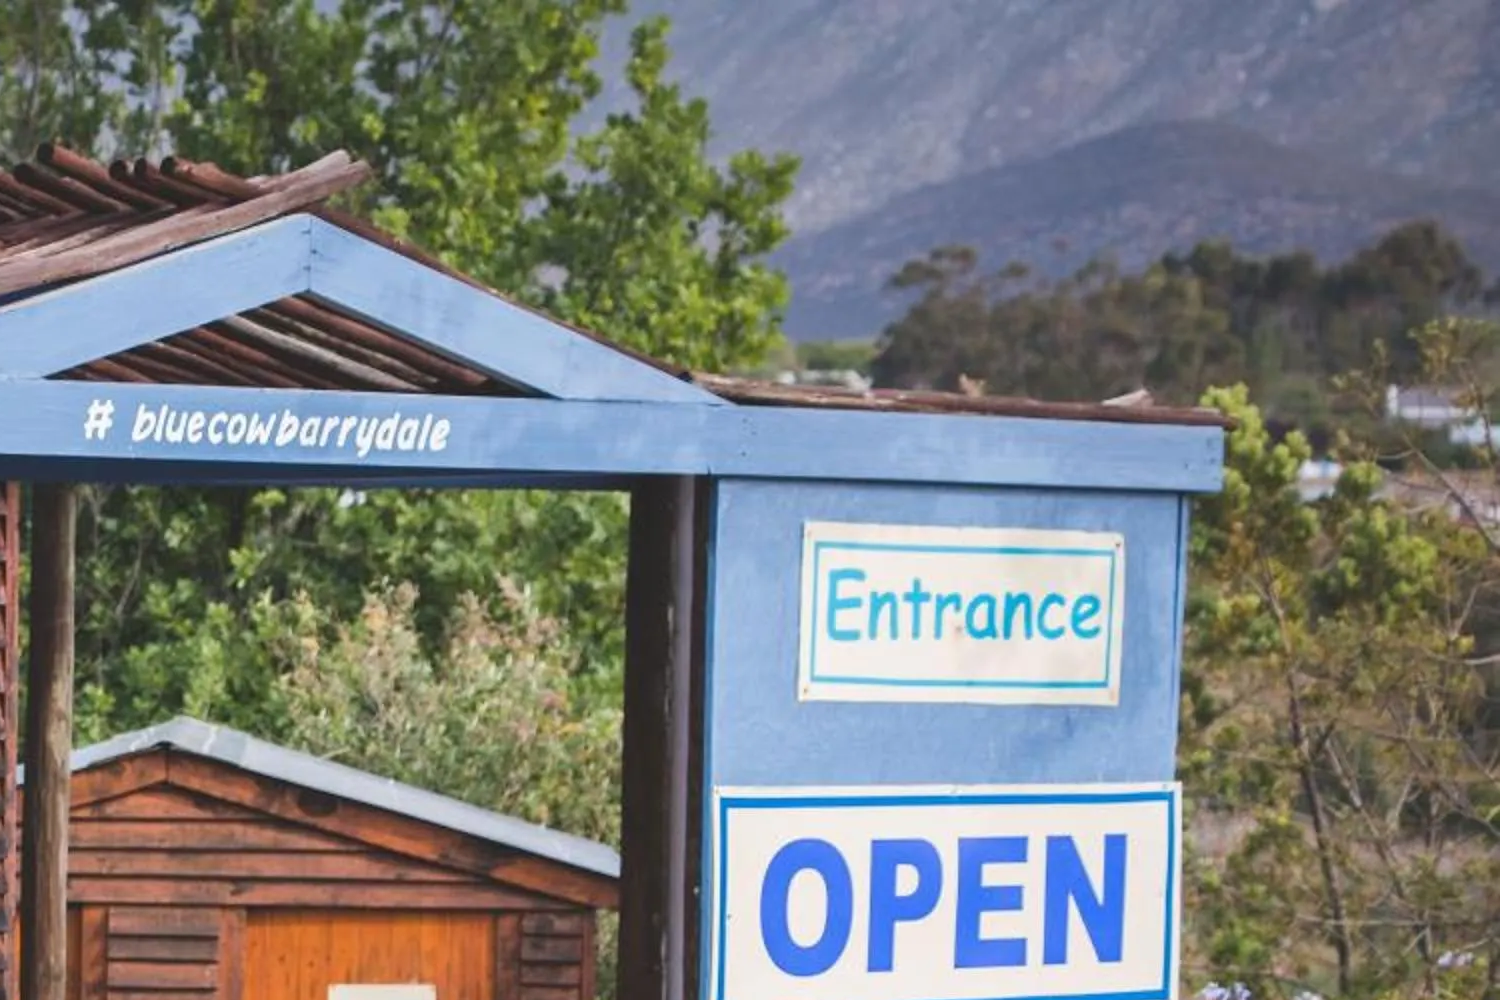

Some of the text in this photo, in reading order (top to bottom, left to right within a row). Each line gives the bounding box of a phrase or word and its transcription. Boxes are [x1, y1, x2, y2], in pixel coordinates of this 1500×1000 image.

[132, 403, 450, 458] bluecowbarrydale
[826, 568, 1102, 642] Entrance
[759, 833, 1128, 977] OPEN
